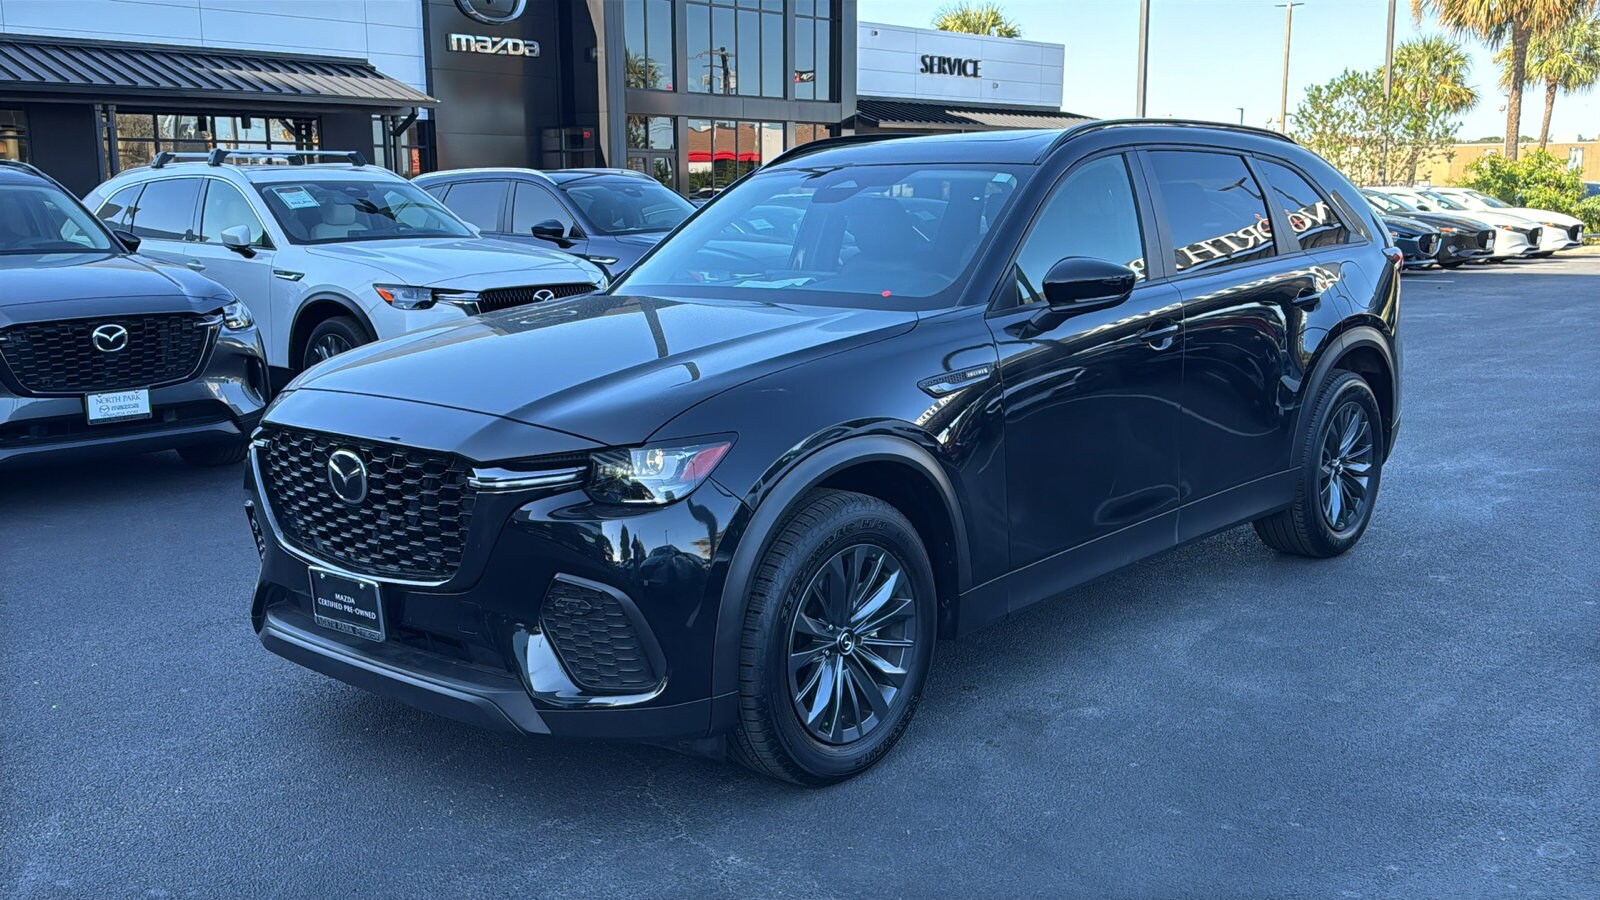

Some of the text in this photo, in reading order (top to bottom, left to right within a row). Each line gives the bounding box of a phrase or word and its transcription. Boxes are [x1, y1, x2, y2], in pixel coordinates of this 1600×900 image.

[920, 54, 982, 78] SERVICE
[95, 396, 121, 405] NORTH
[334, 593, 355, 604] MAZDA
[317, 597, 376, 620] CERTIFIED PRE-OWNED
